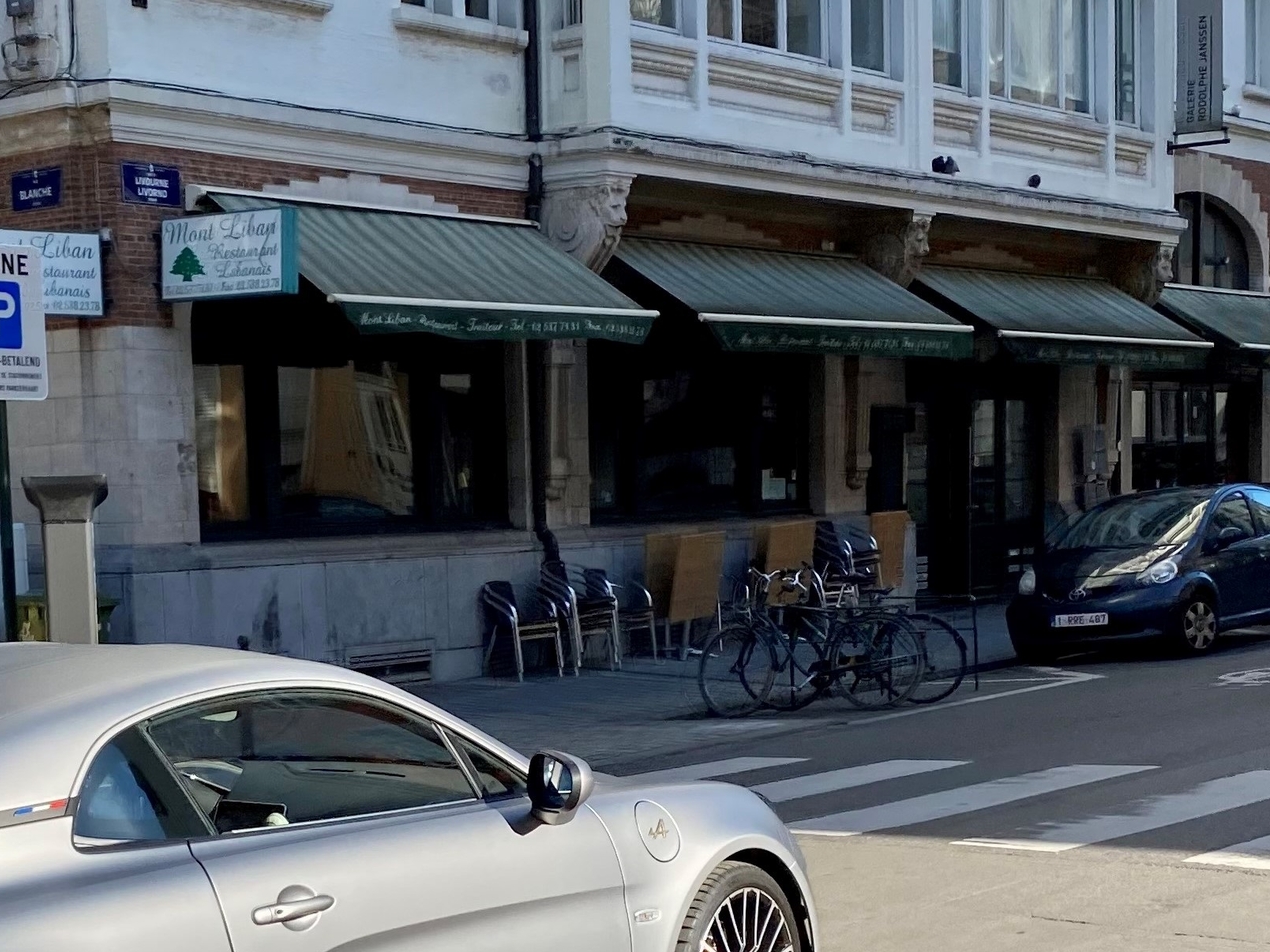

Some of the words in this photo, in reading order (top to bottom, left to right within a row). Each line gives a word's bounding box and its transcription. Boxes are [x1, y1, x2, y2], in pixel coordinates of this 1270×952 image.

[1198, 15, 1208, 63] JANSSEN
[1187, 80, 1196, 123] GALERIE
[1198, 65, 1208, 122] RODOLPHE
[19, 186, 53, 200] BLANCHE
[137, 187, 168, 198] LIVORNO
[165, 222, 213, 245] Mont
[220, 213, 278, 240] Liban
[207, 243, 279, 260] Restaurant
[43, 266, 97, 279] staurant
